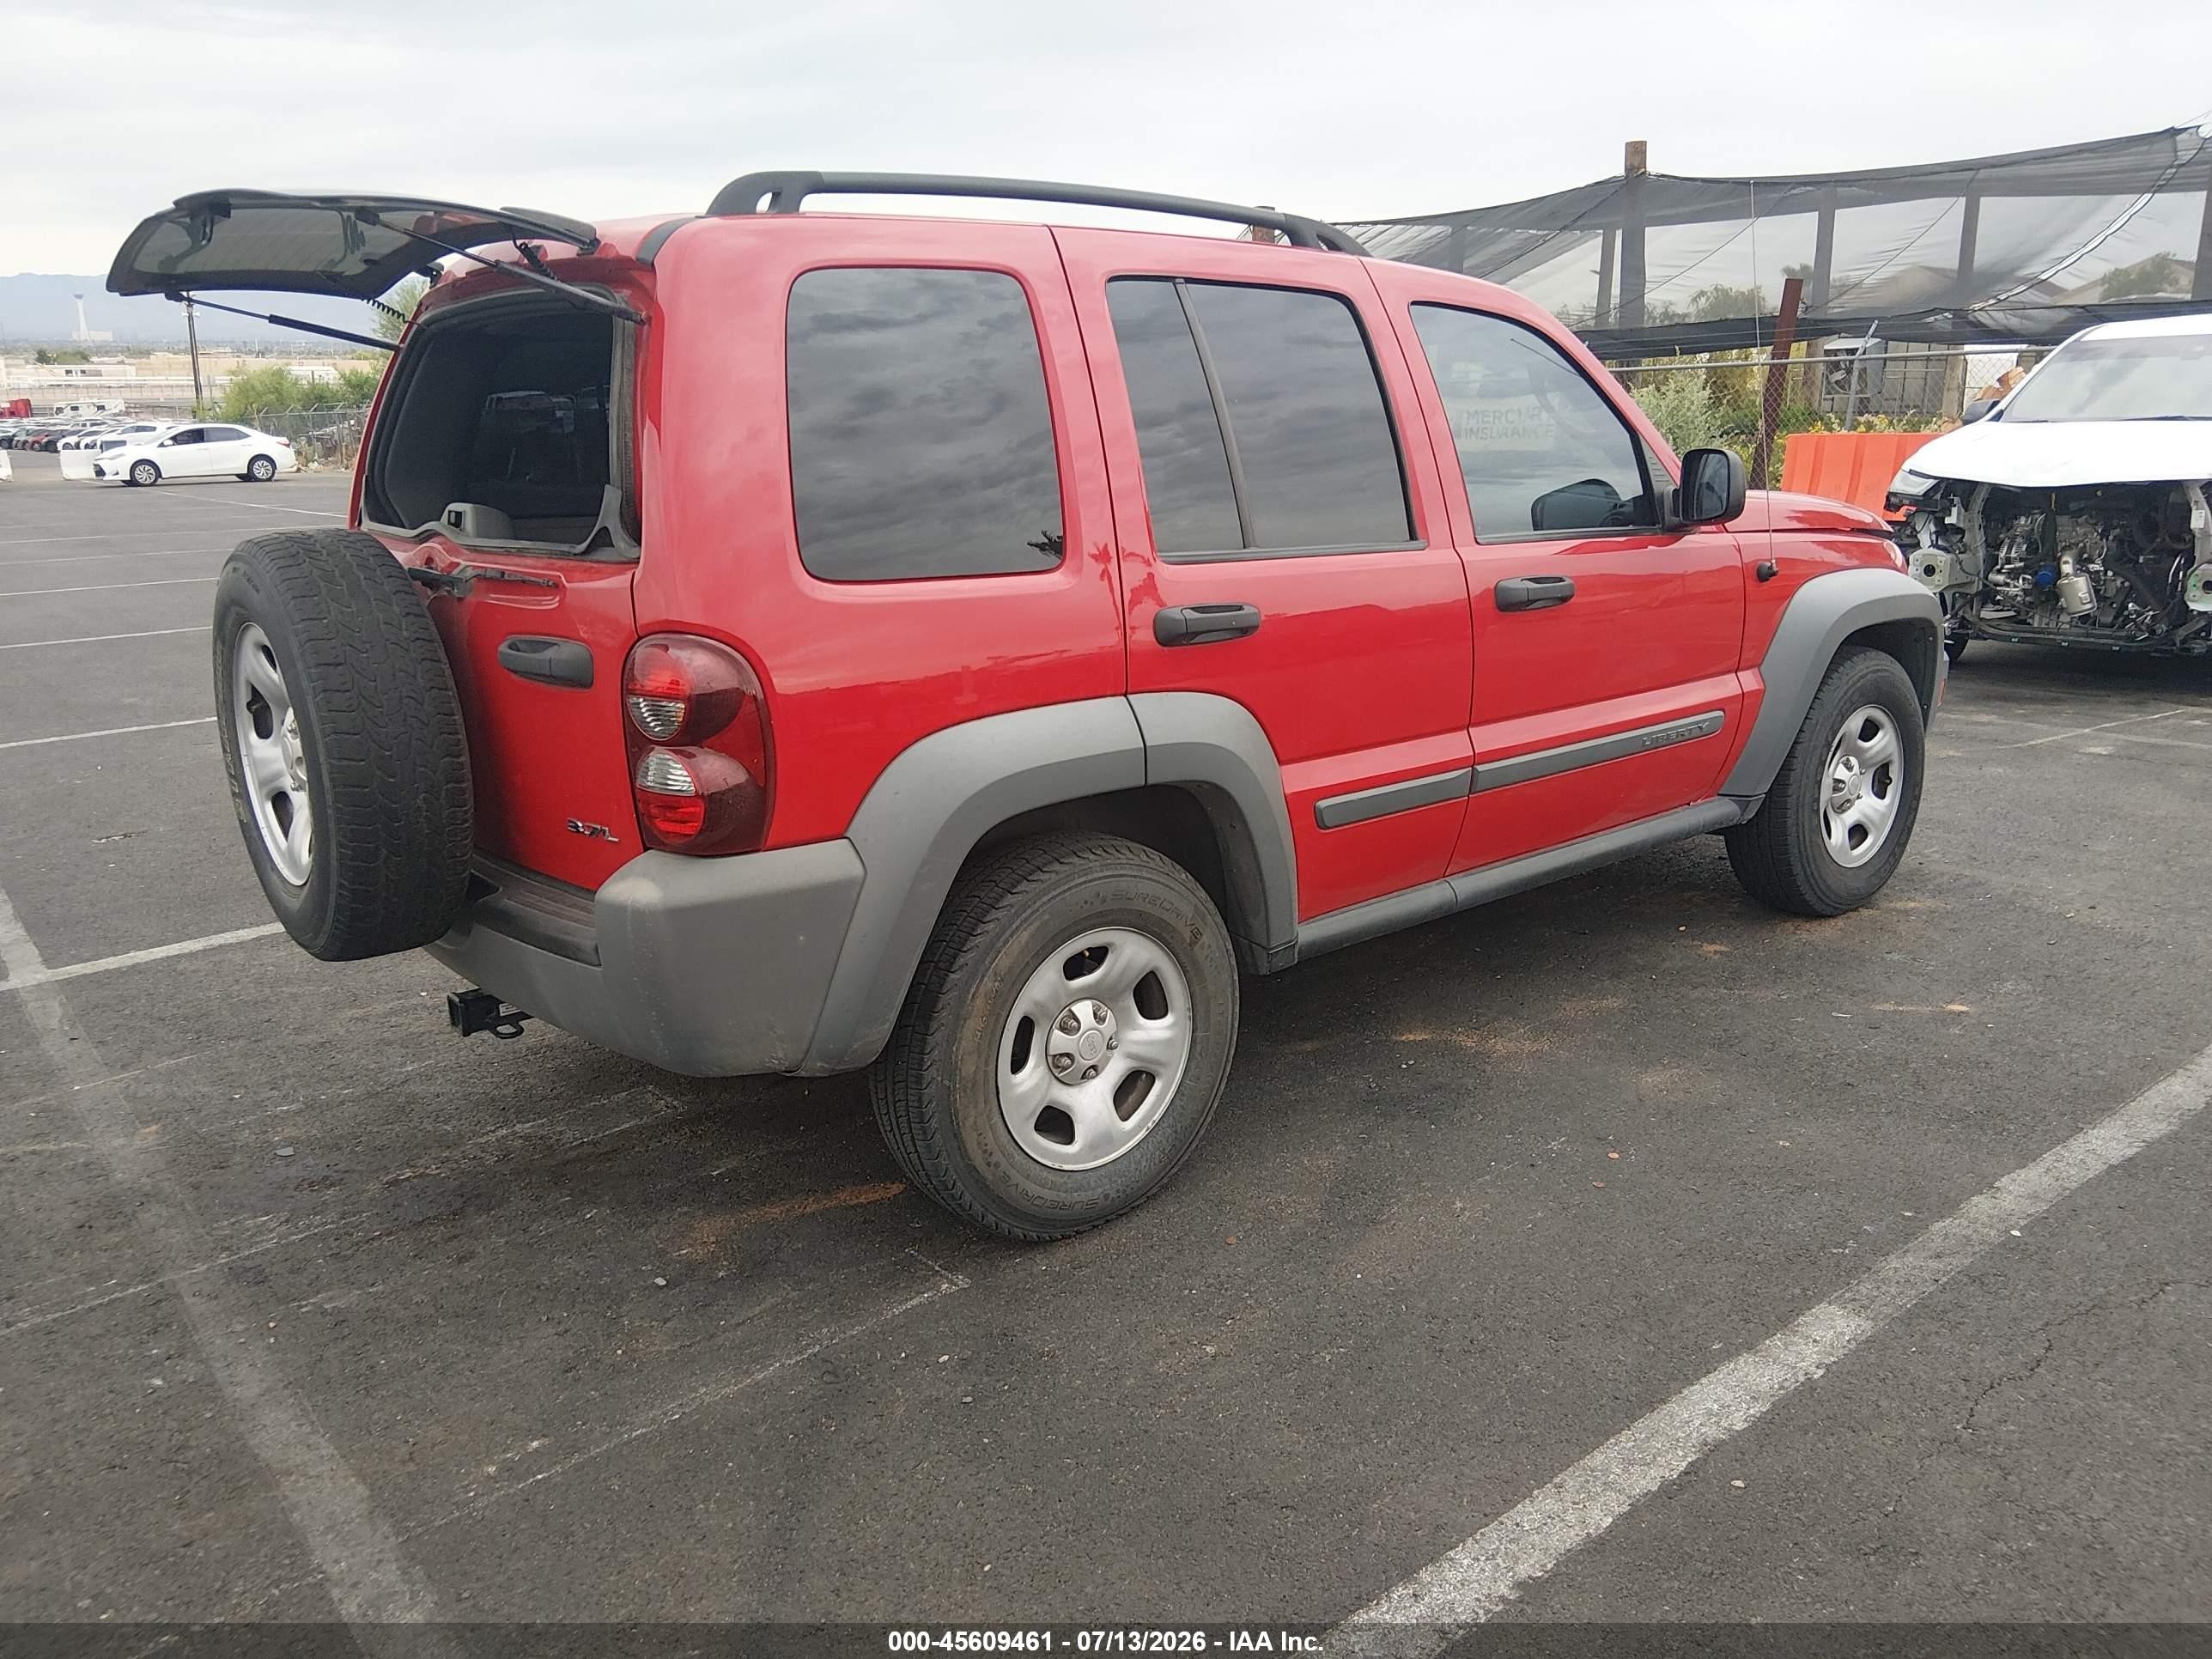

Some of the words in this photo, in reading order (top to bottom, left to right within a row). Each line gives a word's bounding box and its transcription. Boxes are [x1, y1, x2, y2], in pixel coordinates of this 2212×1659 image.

[1466, 406, 1551, 426] MERCUR
[1464, 424, 1554, 441] INSURANCE
[1641, 722, 1710, 747] LIBERTY
[1111, 889, 1203, 940] SUREDRIVE
[1001, 1172, 1101, 1211] SUREDRIVE
